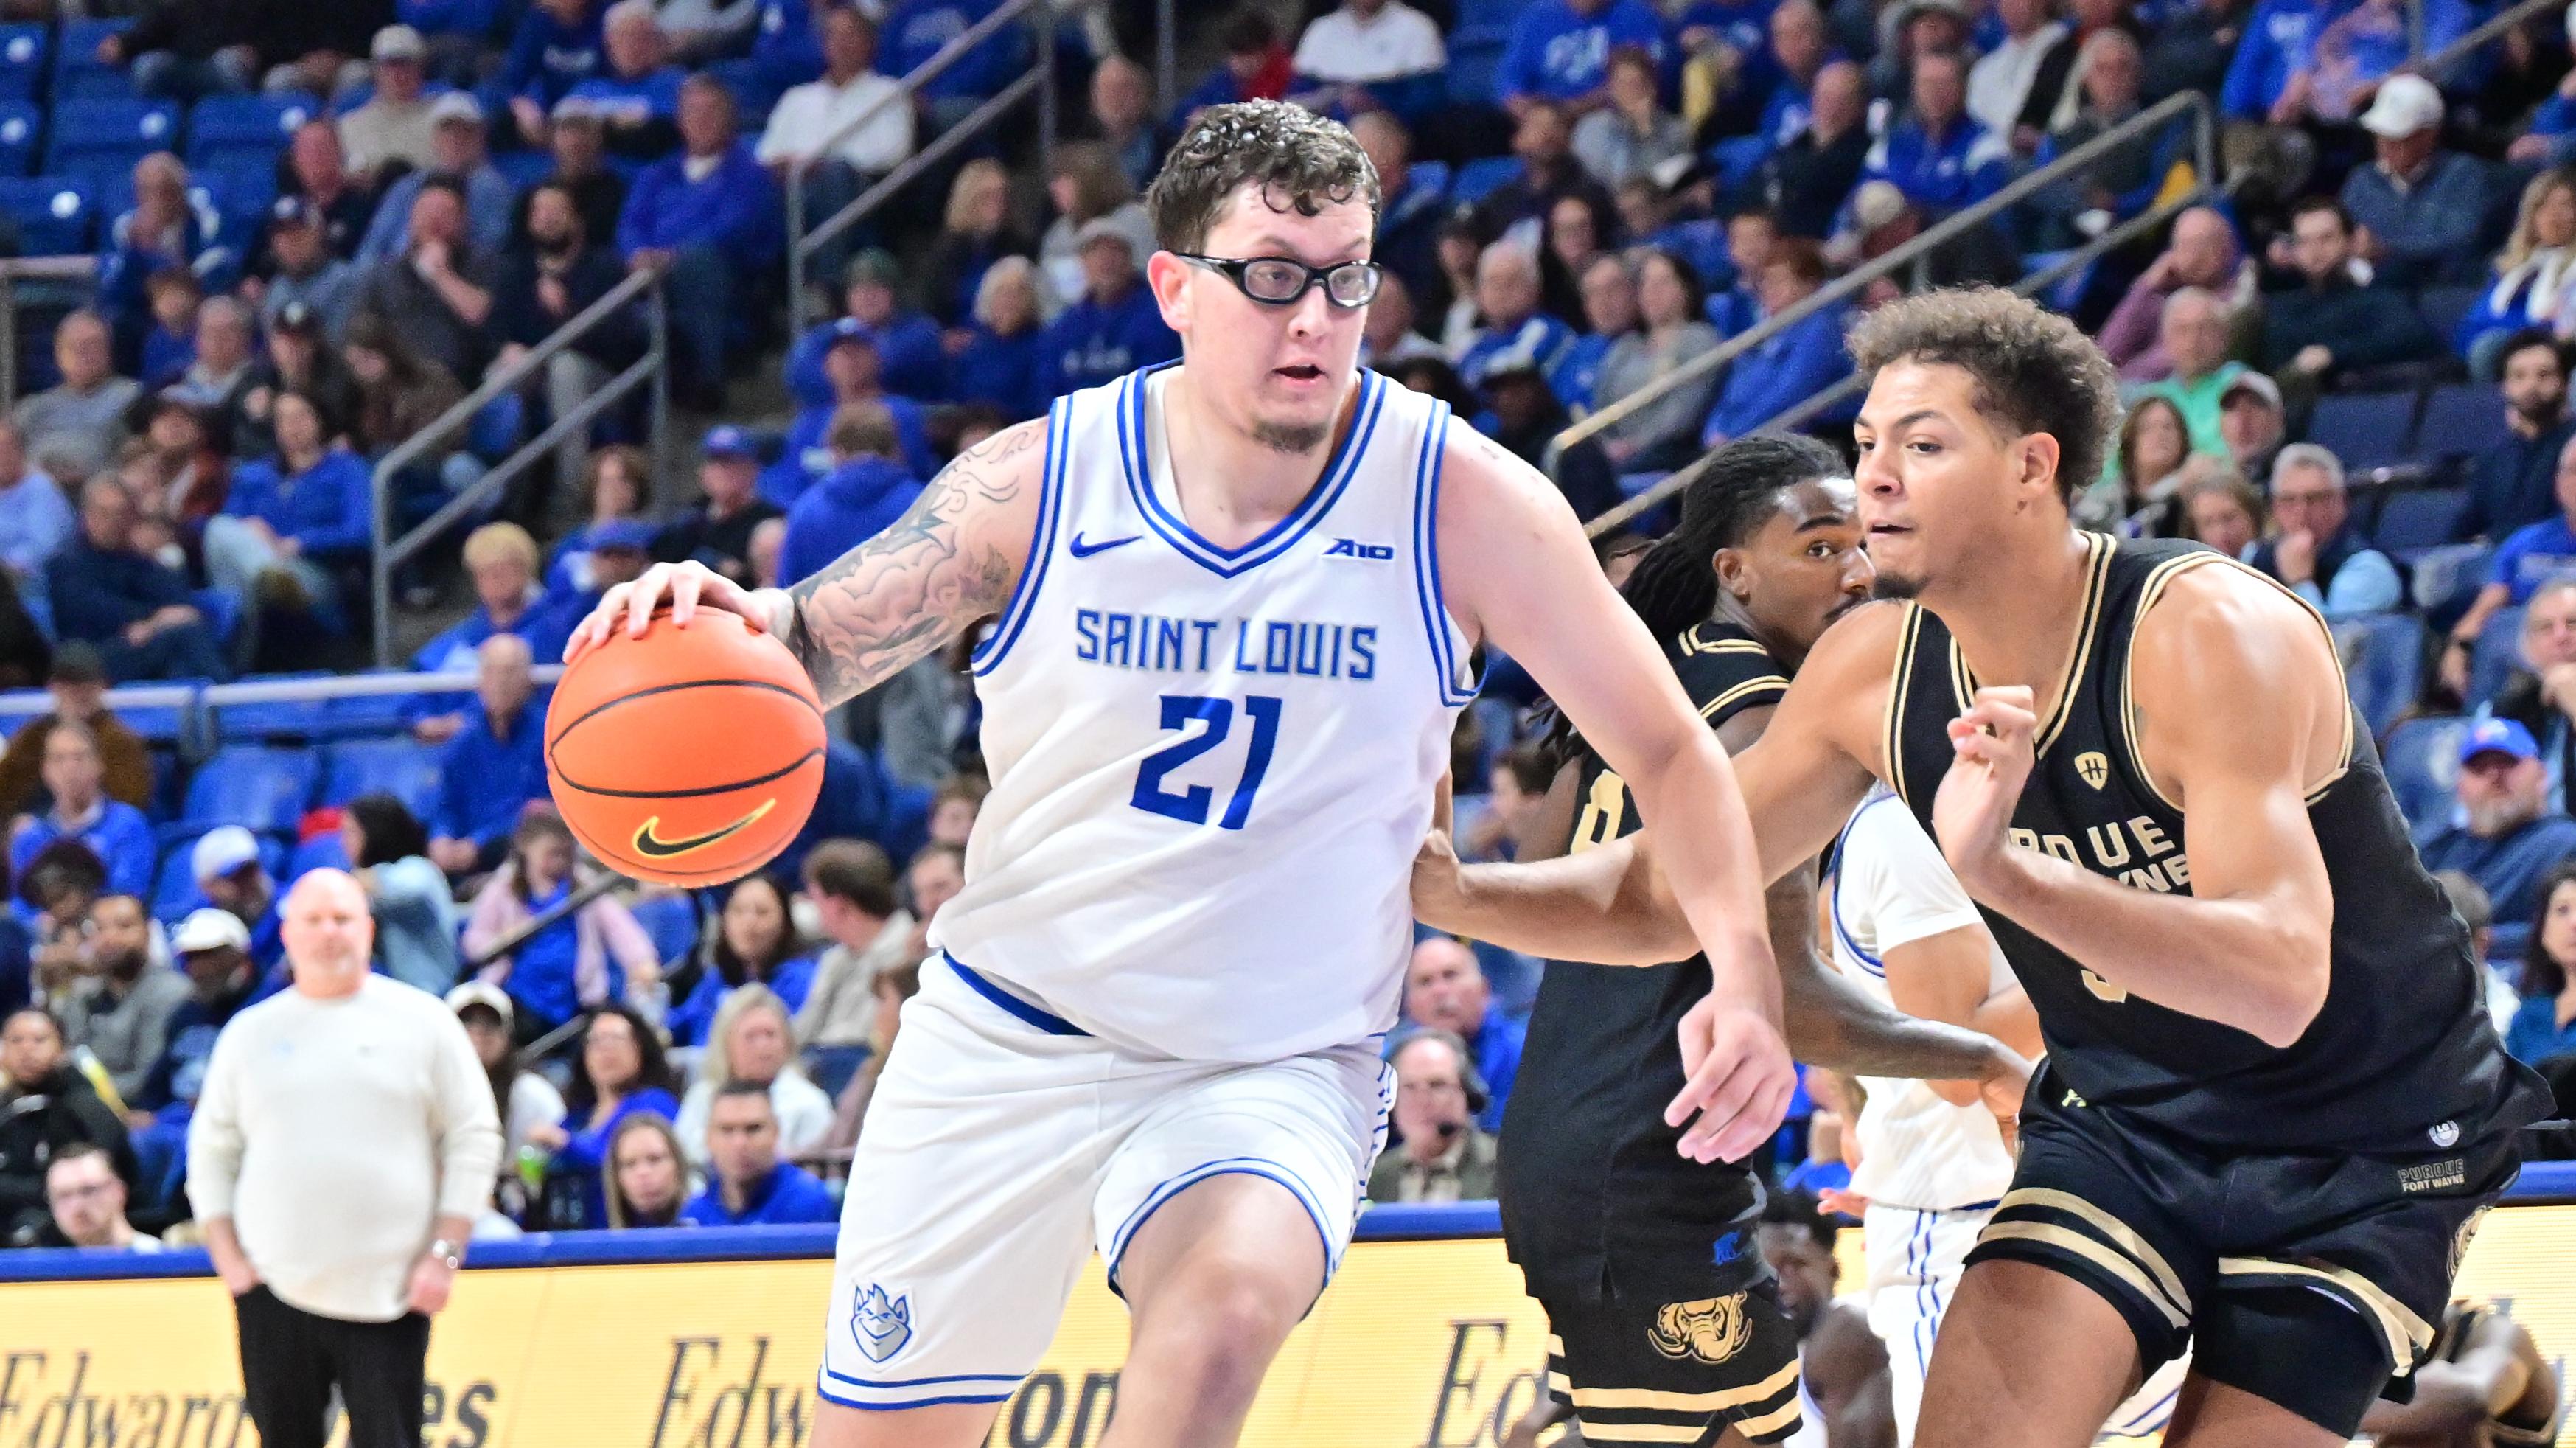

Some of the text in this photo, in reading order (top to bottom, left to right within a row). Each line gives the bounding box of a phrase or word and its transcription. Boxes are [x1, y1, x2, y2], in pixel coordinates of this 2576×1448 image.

[1077, 608, 1378, 681] SAINT LOUIS
[1129, 695, 1282, 830] 21
[2009, 815, 2175, 868] RDUE
[2397, 1158, 2464, 1181] PURDUE
[2403, 1174, 2465, 1192] FORT WAYNE
